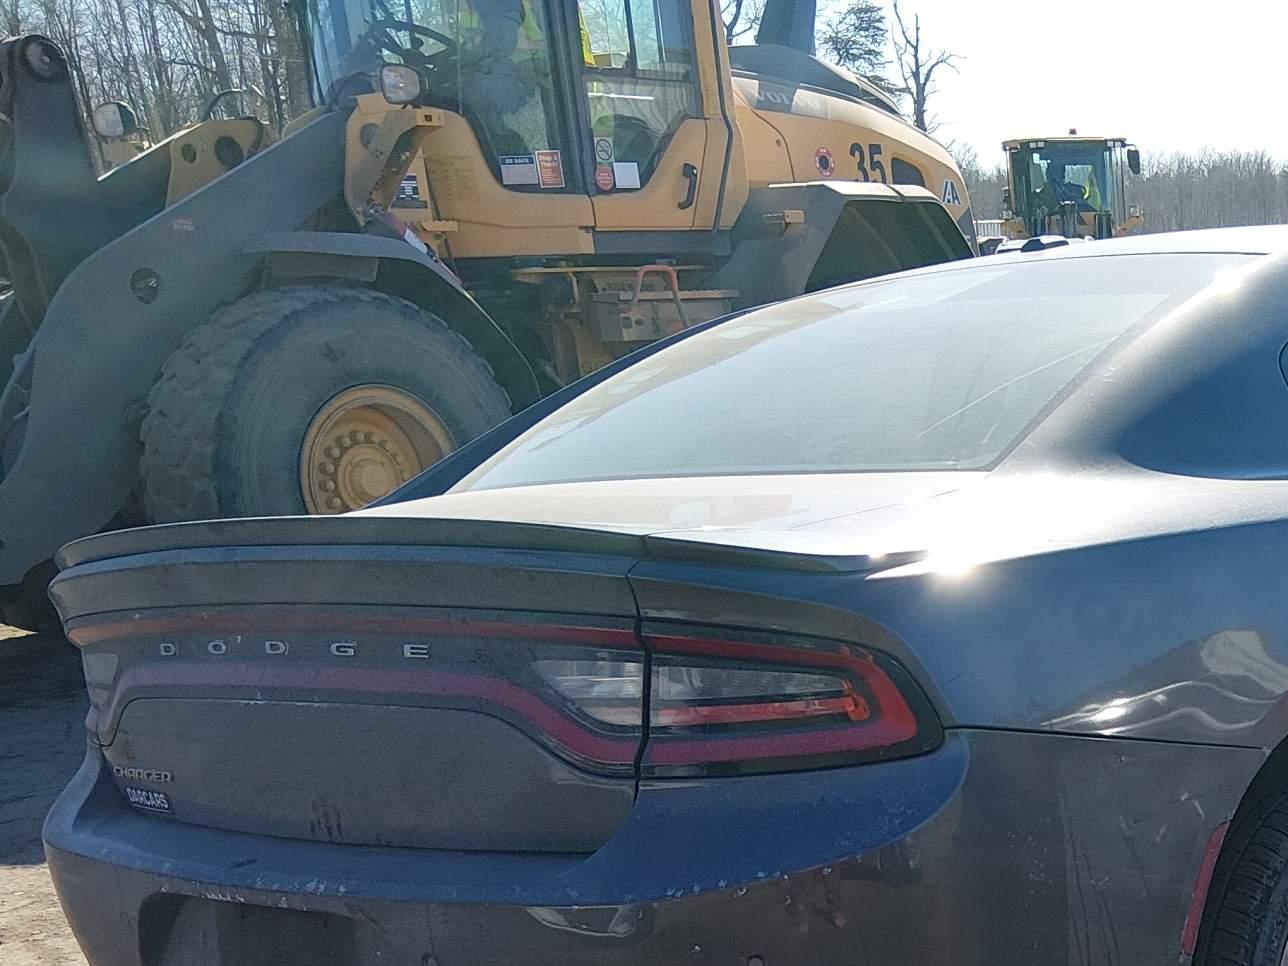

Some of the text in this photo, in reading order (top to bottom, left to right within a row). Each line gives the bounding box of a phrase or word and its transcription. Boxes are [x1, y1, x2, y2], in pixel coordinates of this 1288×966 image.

[849, 142, 886, 183] 35
[159, 640, 431, 659] DODGE
[113, 766, 171, 783] CHARGER
[126, 787, 169, 809] DARCARS
